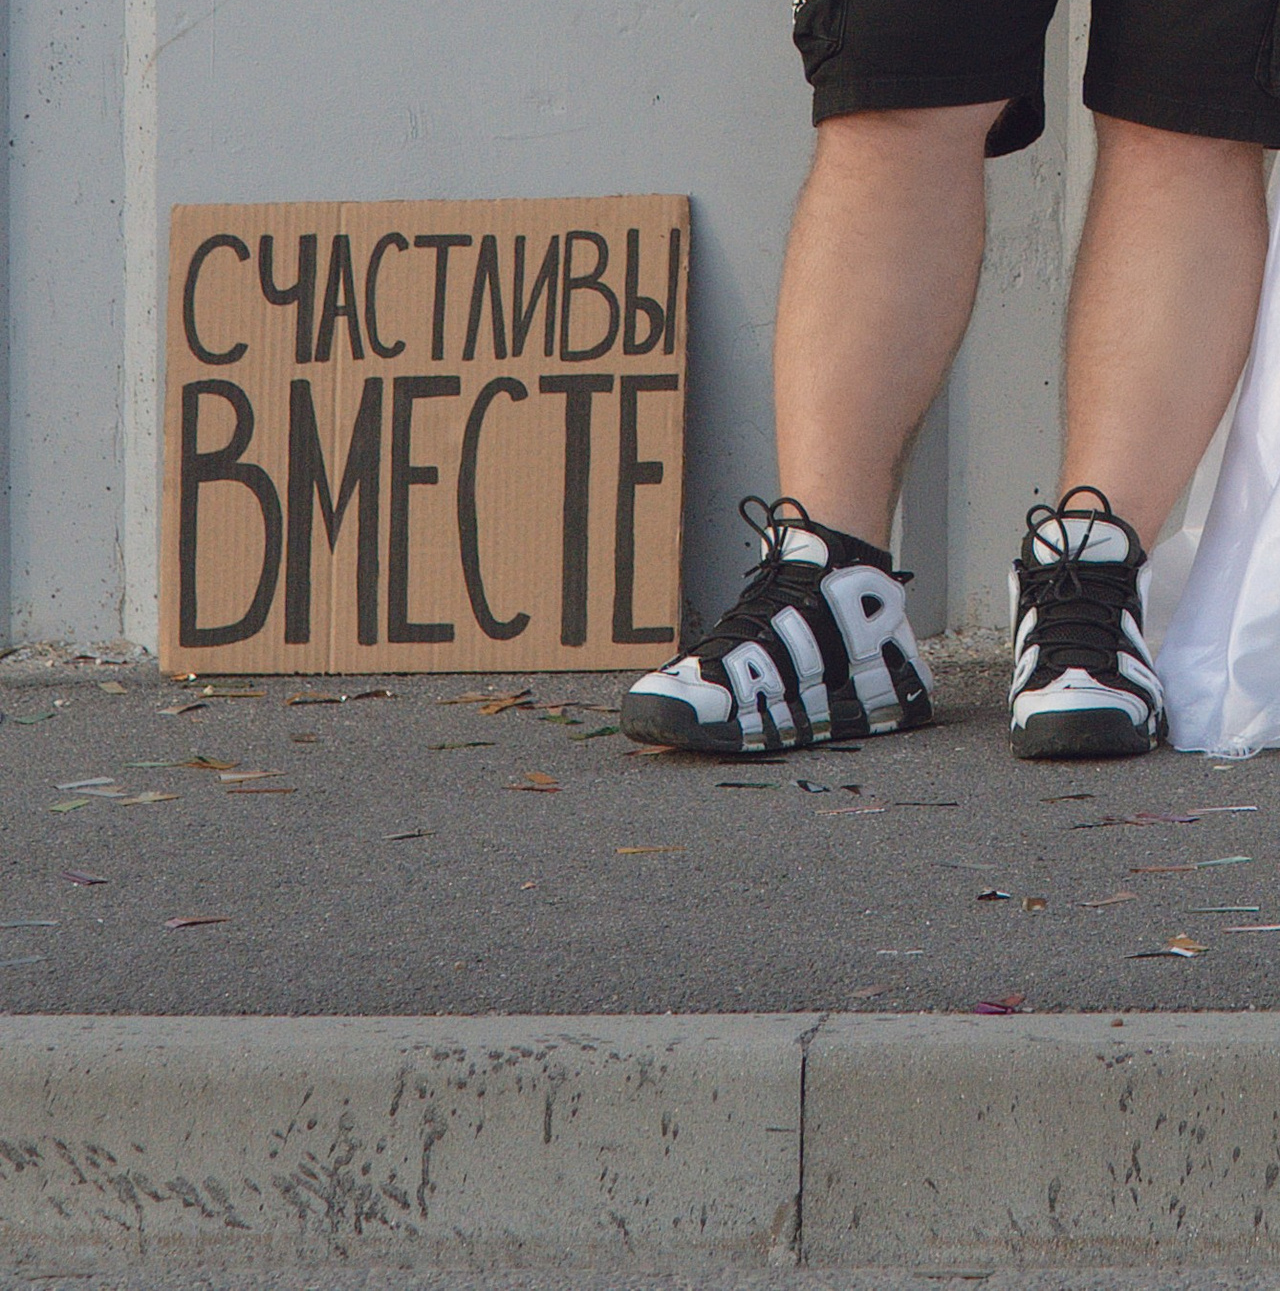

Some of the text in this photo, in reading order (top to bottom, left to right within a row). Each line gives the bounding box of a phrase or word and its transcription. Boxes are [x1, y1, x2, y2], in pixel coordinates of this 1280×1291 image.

[183, 228, 681, 364] СЧАСТЛИВЫ
[179, 375, 679, 647] ВМЕСТЕ
[722, 565, 934, 752] AIR
